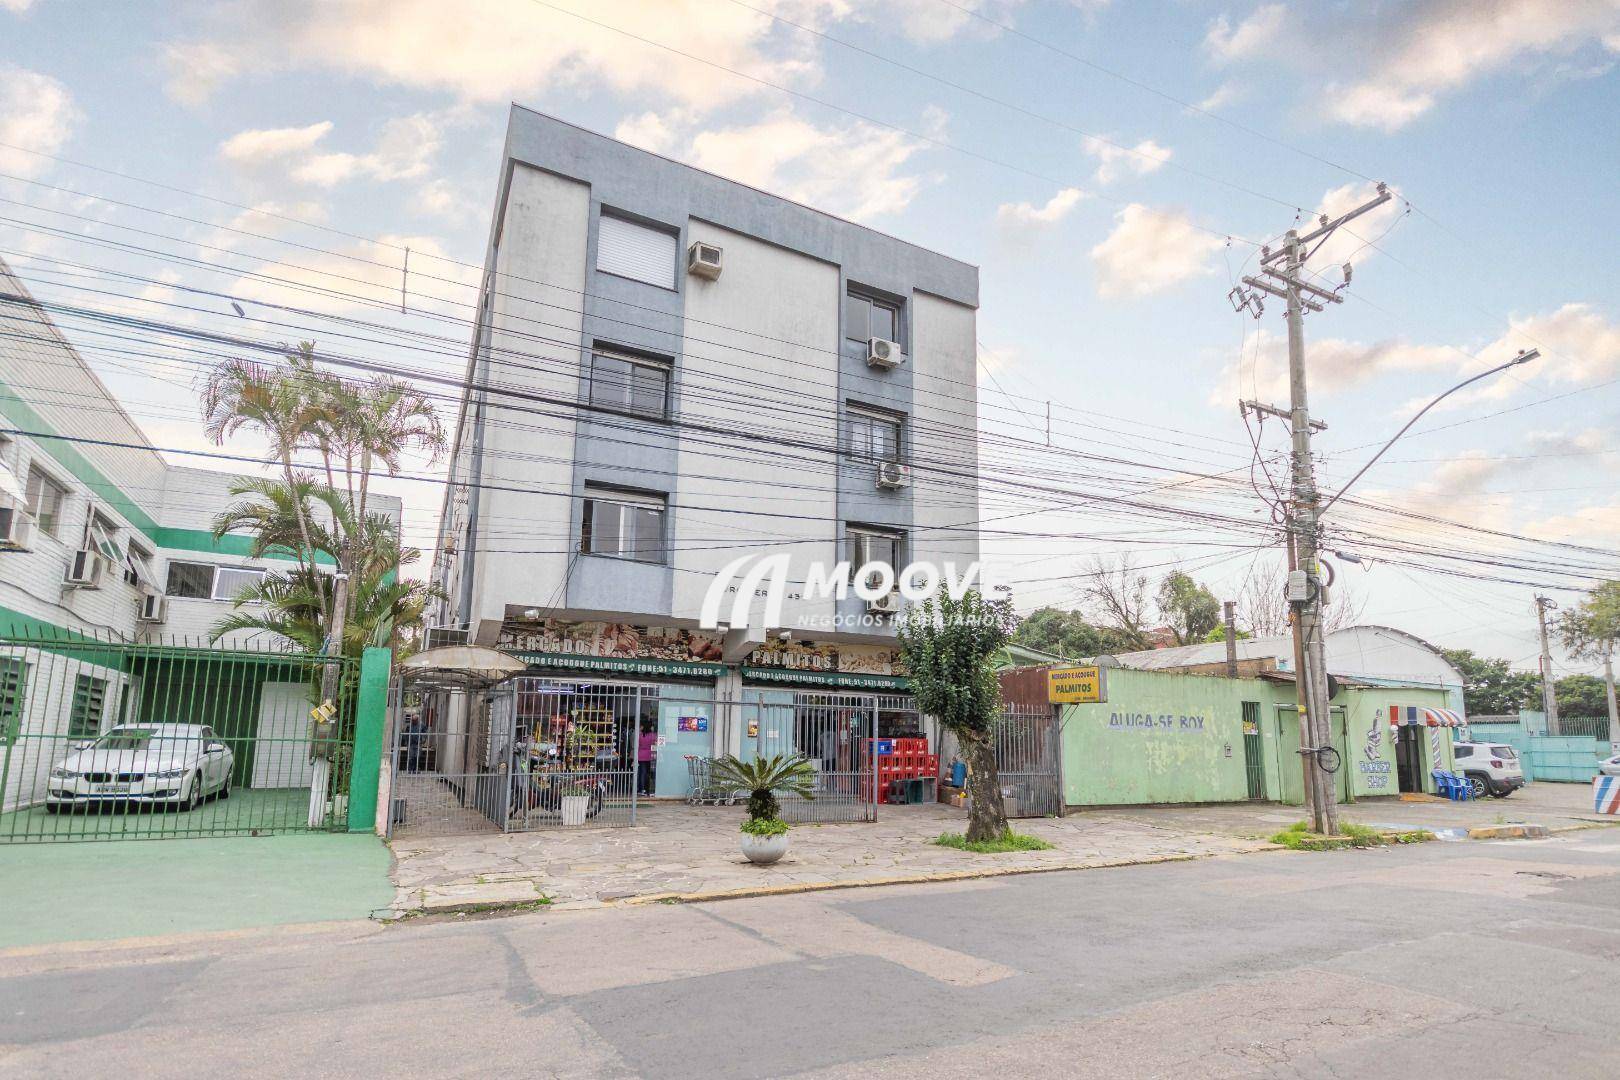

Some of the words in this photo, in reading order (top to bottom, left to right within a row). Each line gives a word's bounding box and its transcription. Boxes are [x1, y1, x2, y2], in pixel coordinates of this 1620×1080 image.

[752, 650, 832, 669] PALMITOS
[590, 661, 627, 671] PALMITOS
[1055, 683, 1092, 693] PALMITOS
